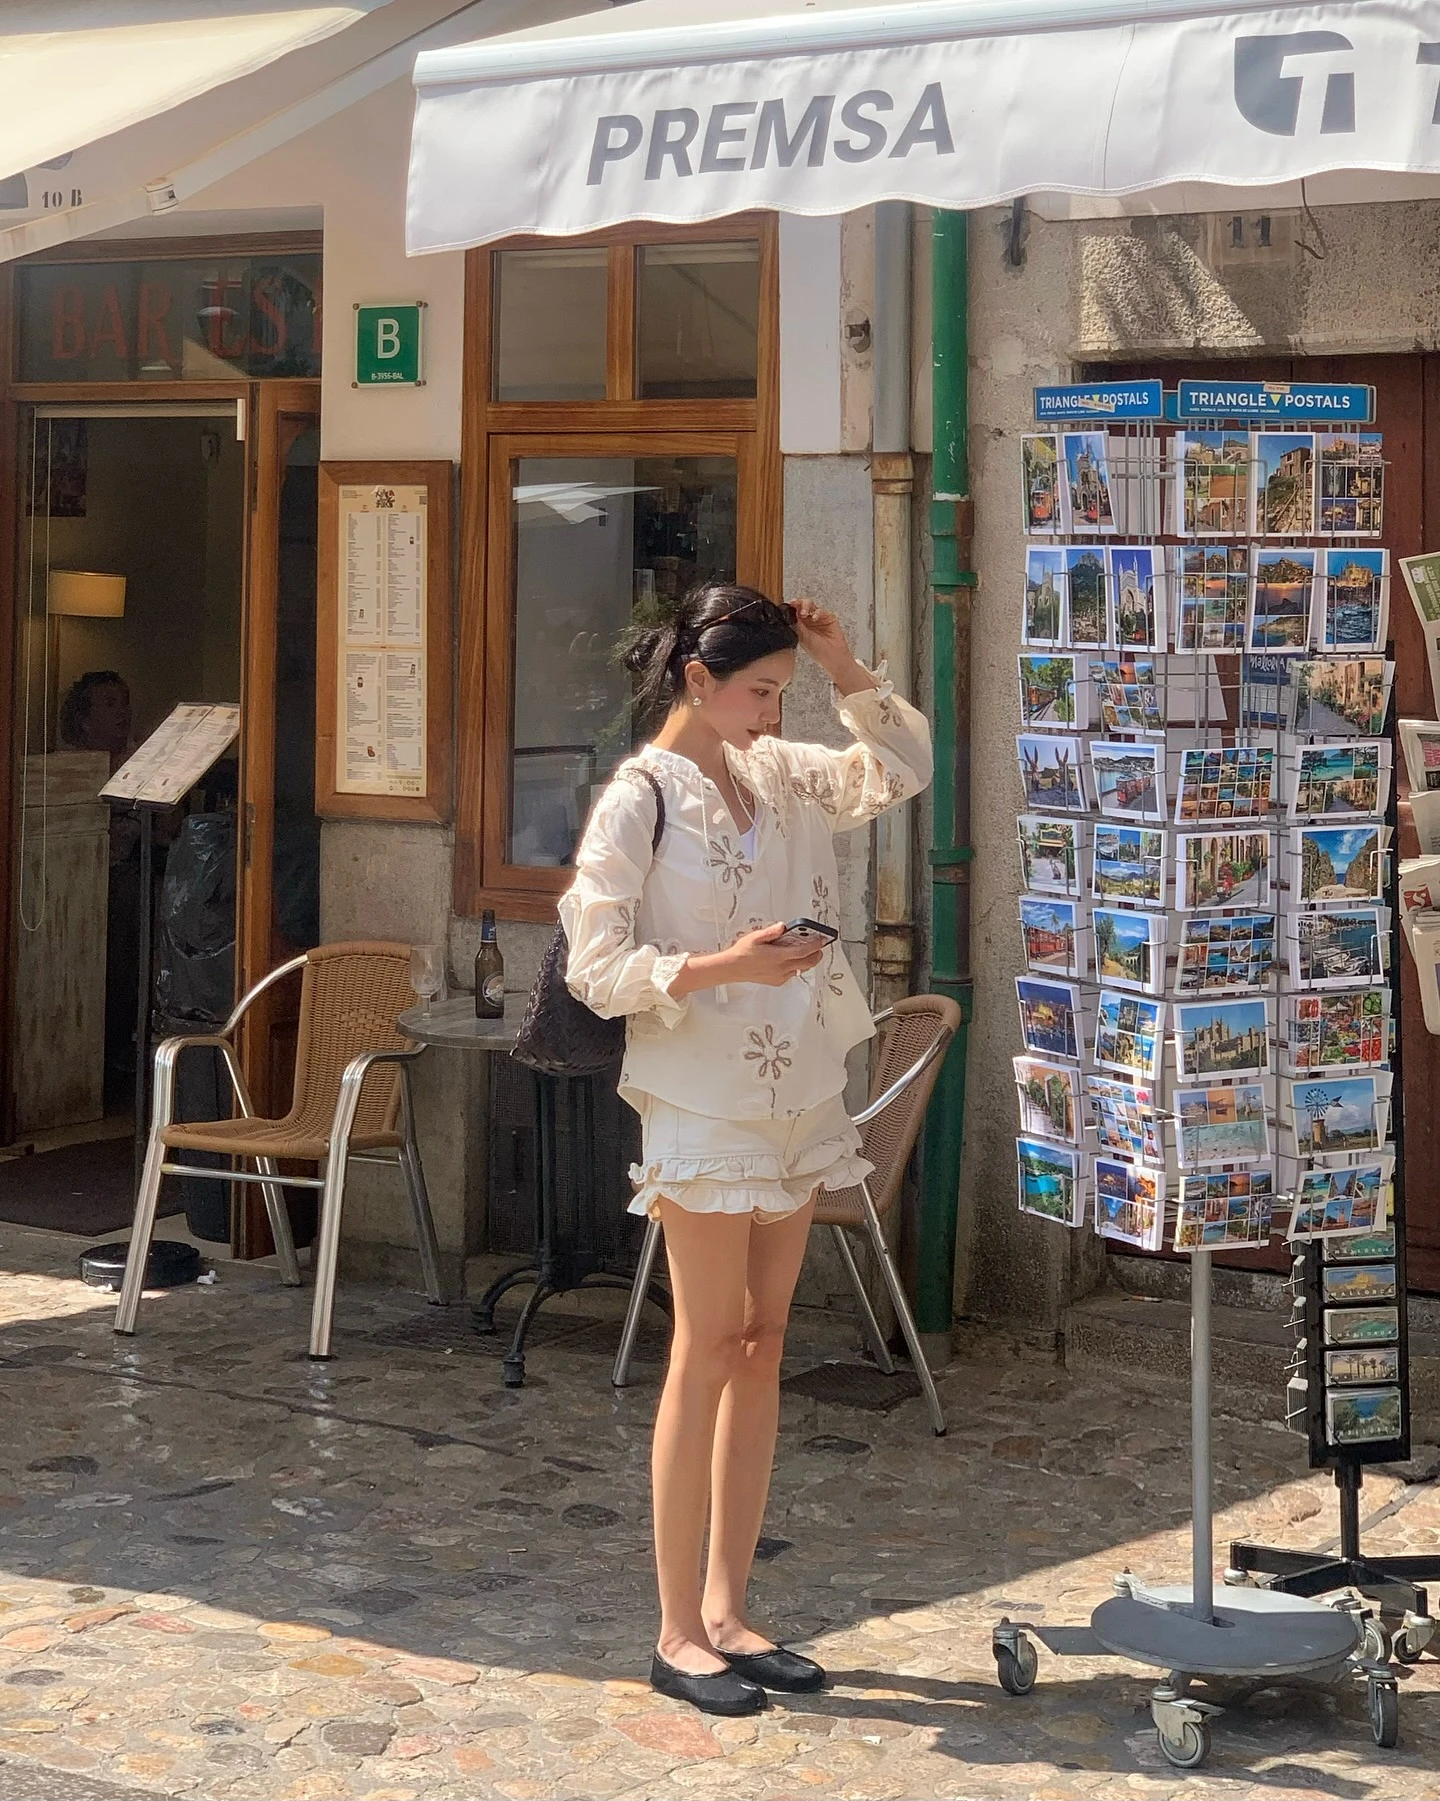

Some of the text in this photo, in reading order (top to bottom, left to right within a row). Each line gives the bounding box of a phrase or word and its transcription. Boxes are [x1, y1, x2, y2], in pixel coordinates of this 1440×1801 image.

[587, 81, 955, 186] PREMSA
[42, 189, 82, 208] 10 B
[52, 281, 179, 364] BAR
[378, 318, 401, 359] B
[1102, 391, 1149, 406] POSTALS
[1189, 391, 1351, 409] TRIANGLE POSTALS
[1331, 1288, 1393, 1297] MALLORCA
